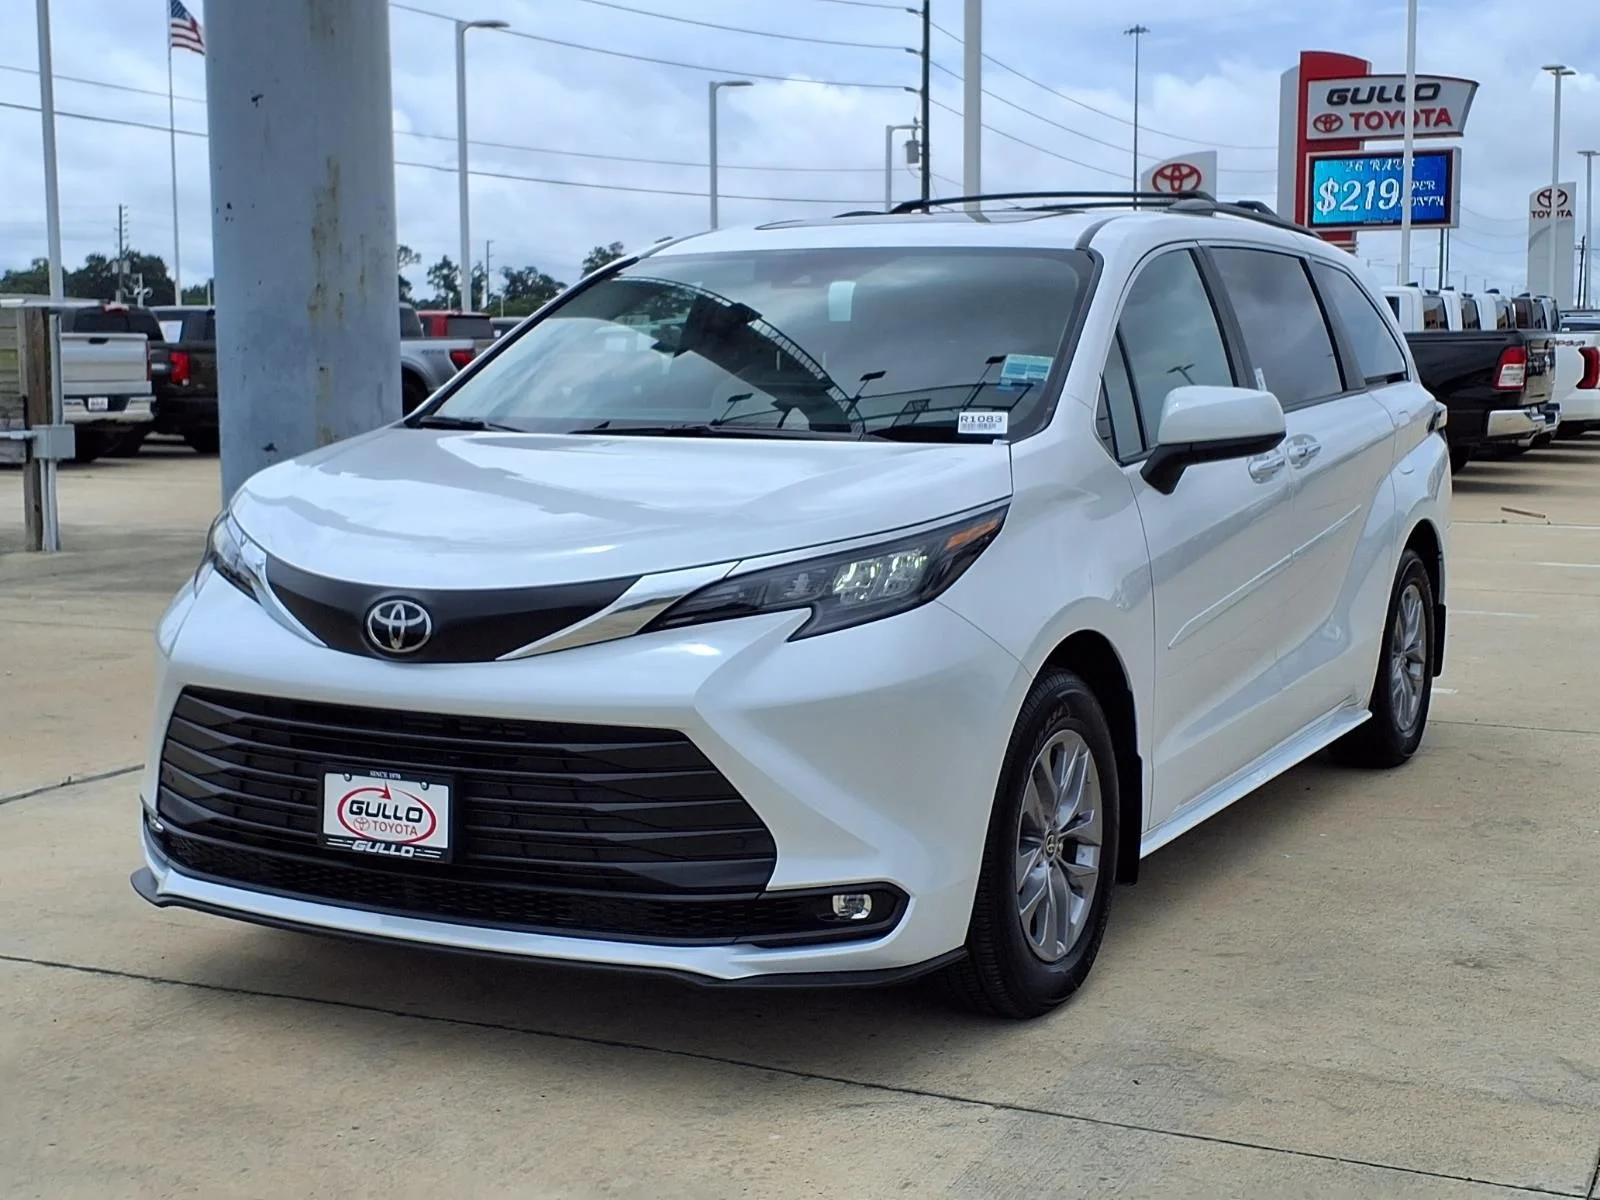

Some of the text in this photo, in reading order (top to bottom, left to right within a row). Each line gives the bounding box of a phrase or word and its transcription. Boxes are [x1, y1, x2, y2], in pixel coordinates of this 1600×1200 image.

[1326, 83, 1441, 105] GULLO
[1316, 177, 1400, 216] $219
[1531, 210, 1573, 218] TOYTA
[961, 415, 1002, 423] R1083
[349, 800, 423, 823] GULLO
[372, 820, 418, 836] TOYOTA
[352, 840, 414, 857] GULLO
